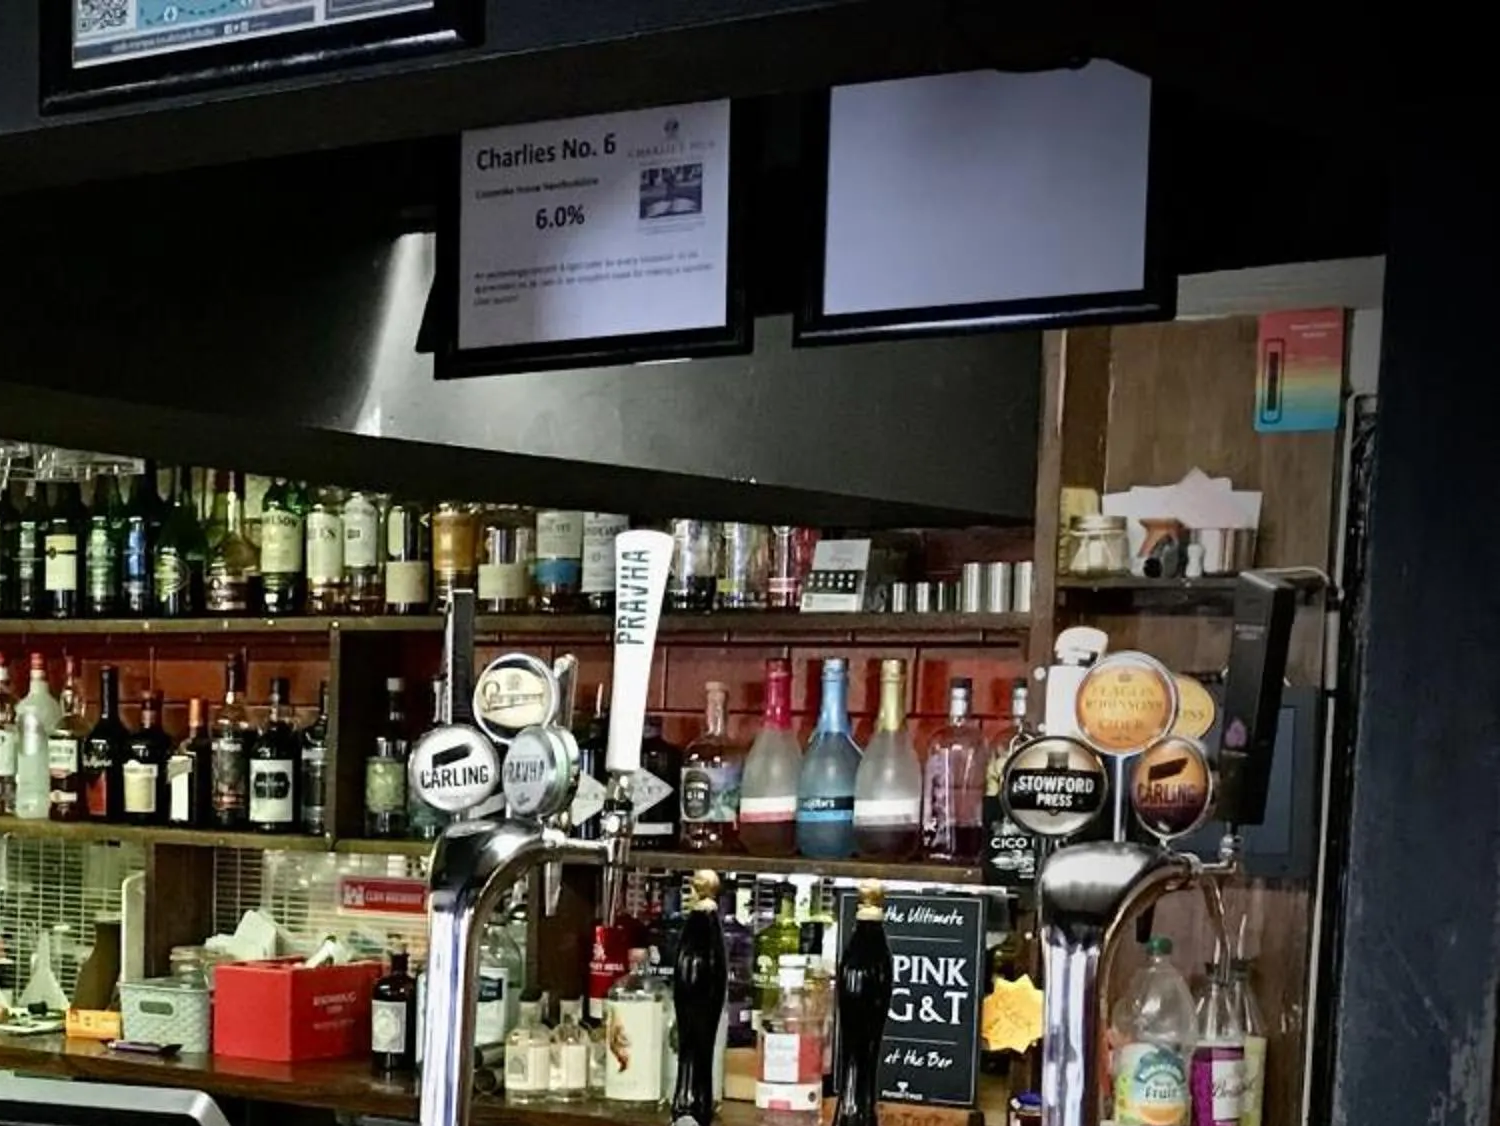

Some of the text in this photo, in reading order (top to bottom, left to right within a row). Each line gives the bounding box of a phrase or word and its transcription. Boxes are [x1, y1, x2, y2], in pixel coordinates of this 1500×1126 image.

[477, 133, 616, 171] Charlies No. 6
[535, 204, 586, 230] 6.0%
[615, 548, 651, 645] PRAVHA
[420, 764, 490, 790] CARLING
[1014, 774, 1095, 795] STOWFORD
[1035, 793, 1073, 808] PRESS
[991, 837, 1028, 849] CICO
[885, 905, 965, 926] the Ultimate
[892, 954, 969, 987] PINK
[887, 987, 968, 1025] G&T
[884, 1048, 953, 1068] at the Bar
